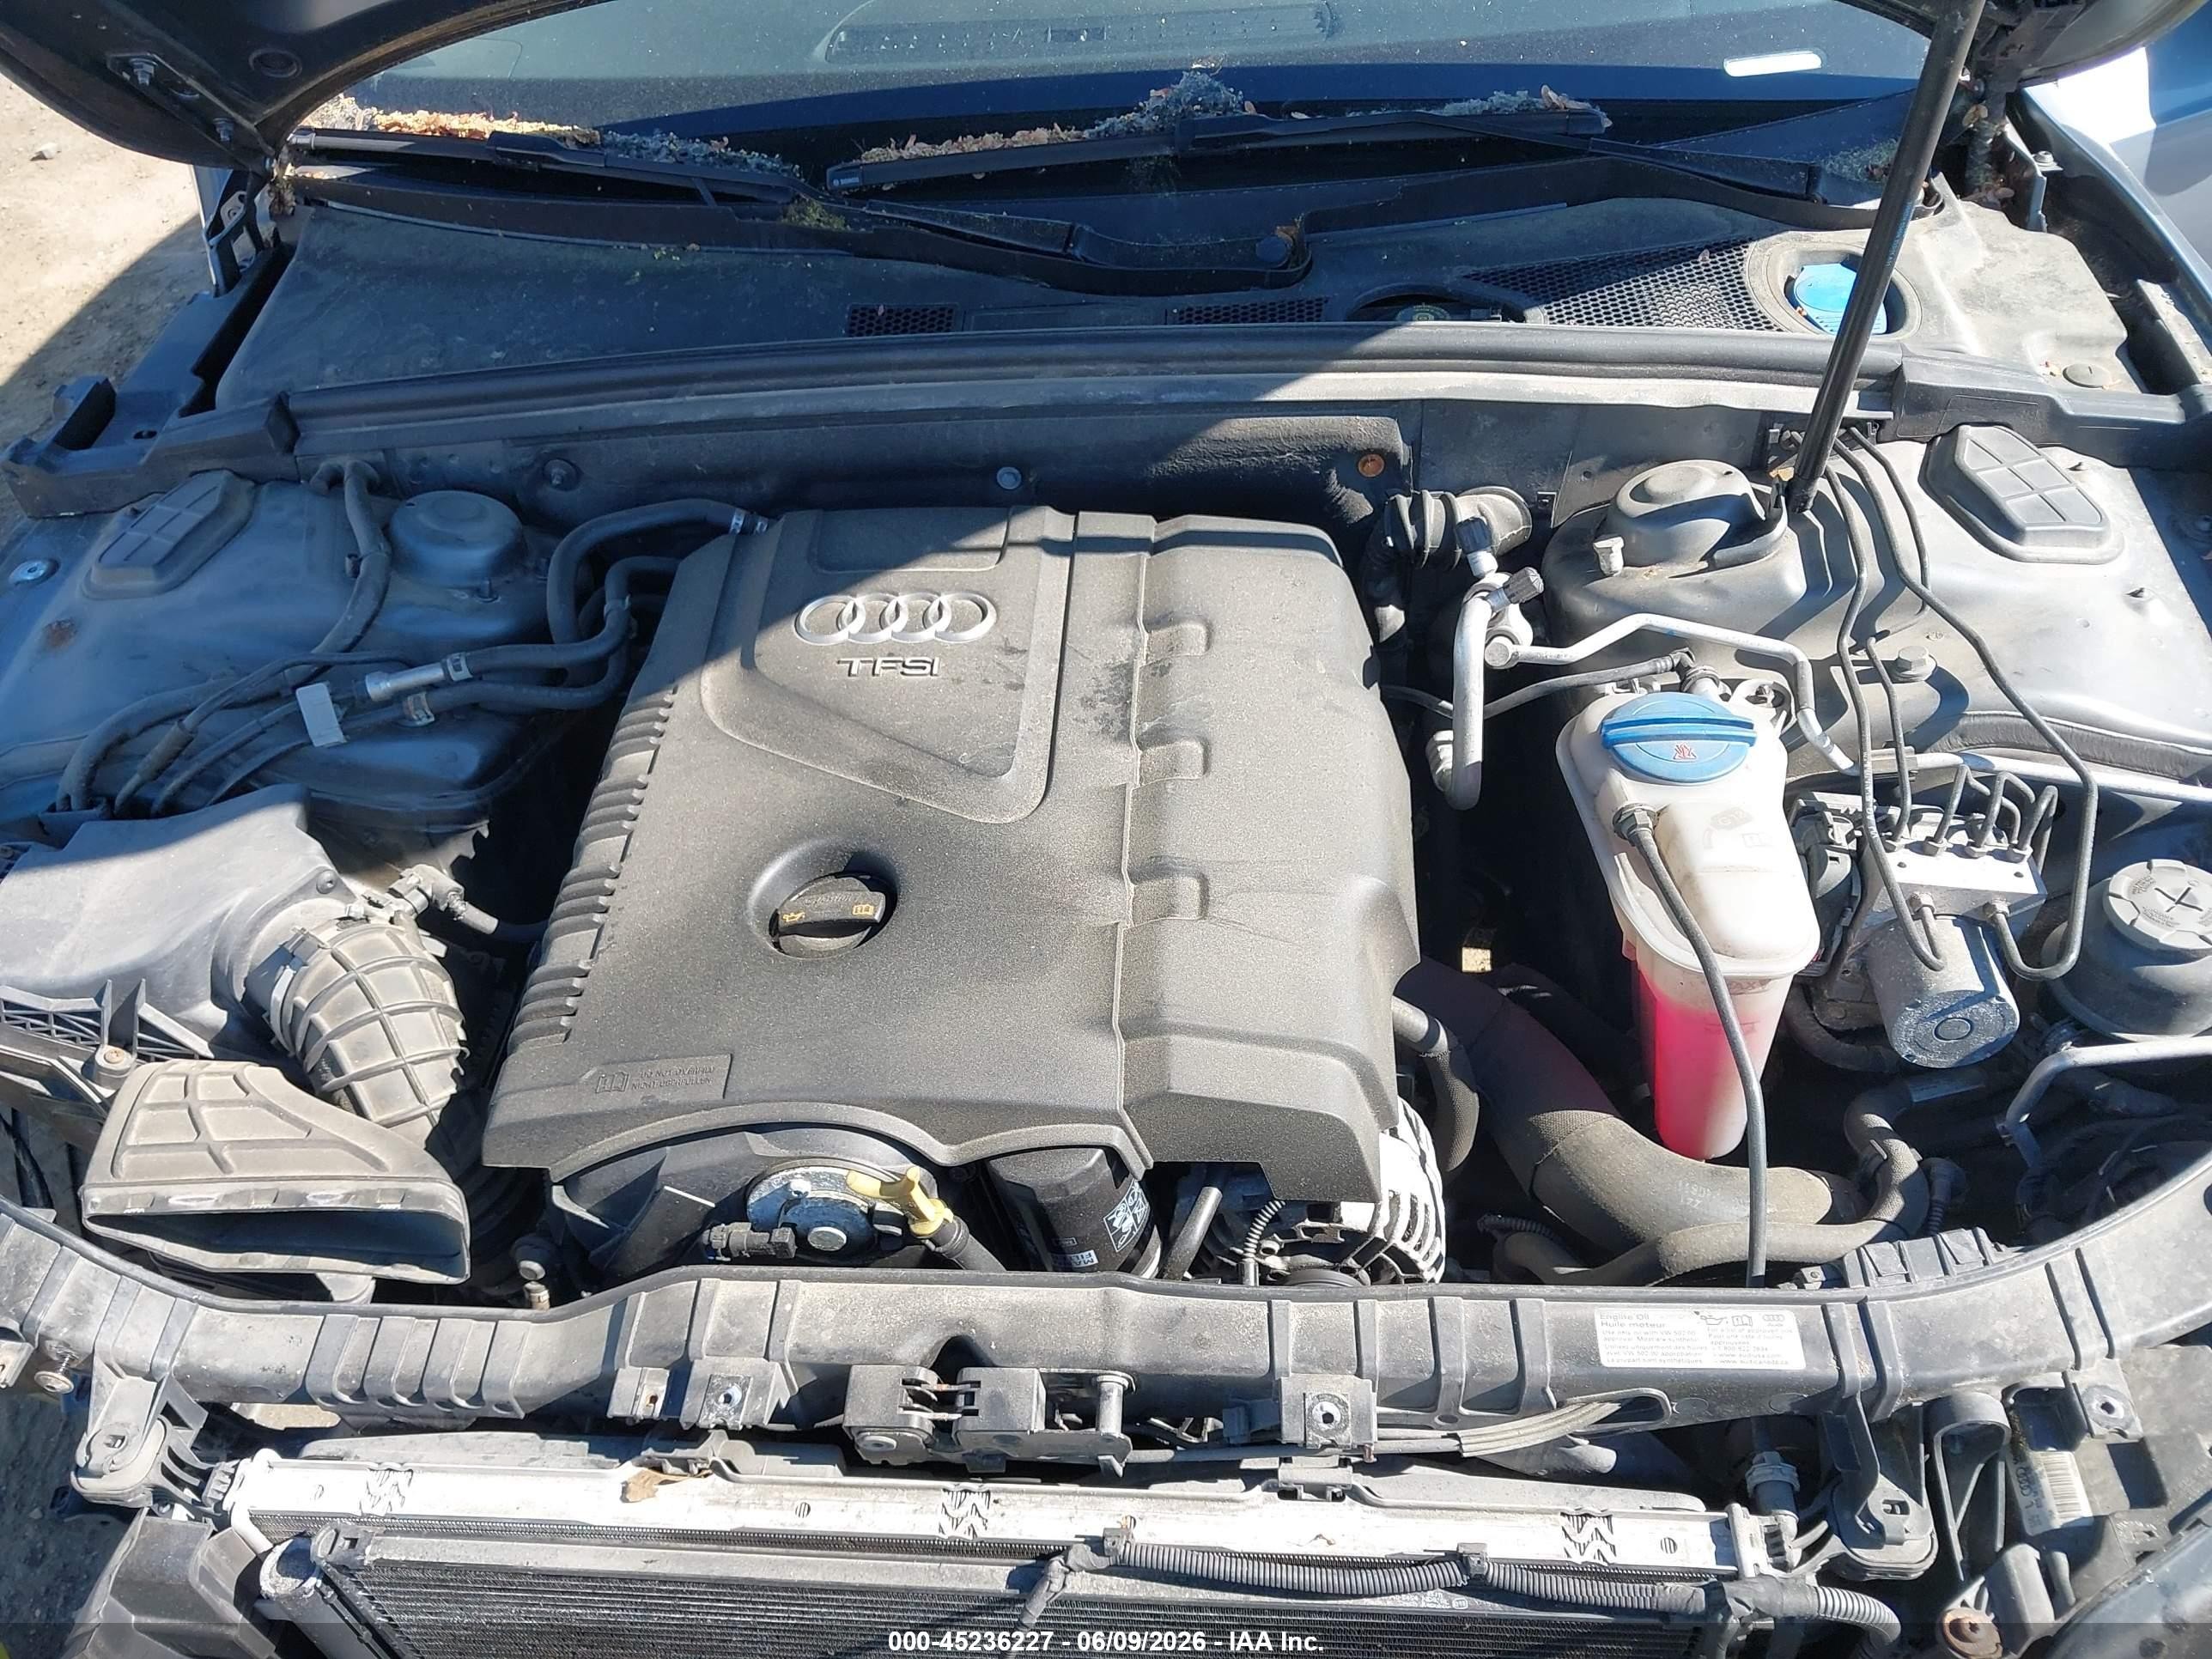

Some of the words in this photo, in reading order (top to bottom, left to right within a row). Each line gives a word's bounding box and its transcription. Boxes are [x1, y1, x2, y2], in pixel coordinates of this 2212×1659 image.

[837, 657, 940, 677] TFSI
[1600, 1312, 1633, 1322] Engine
[1635, 1312, 1650, 1321] Oil
